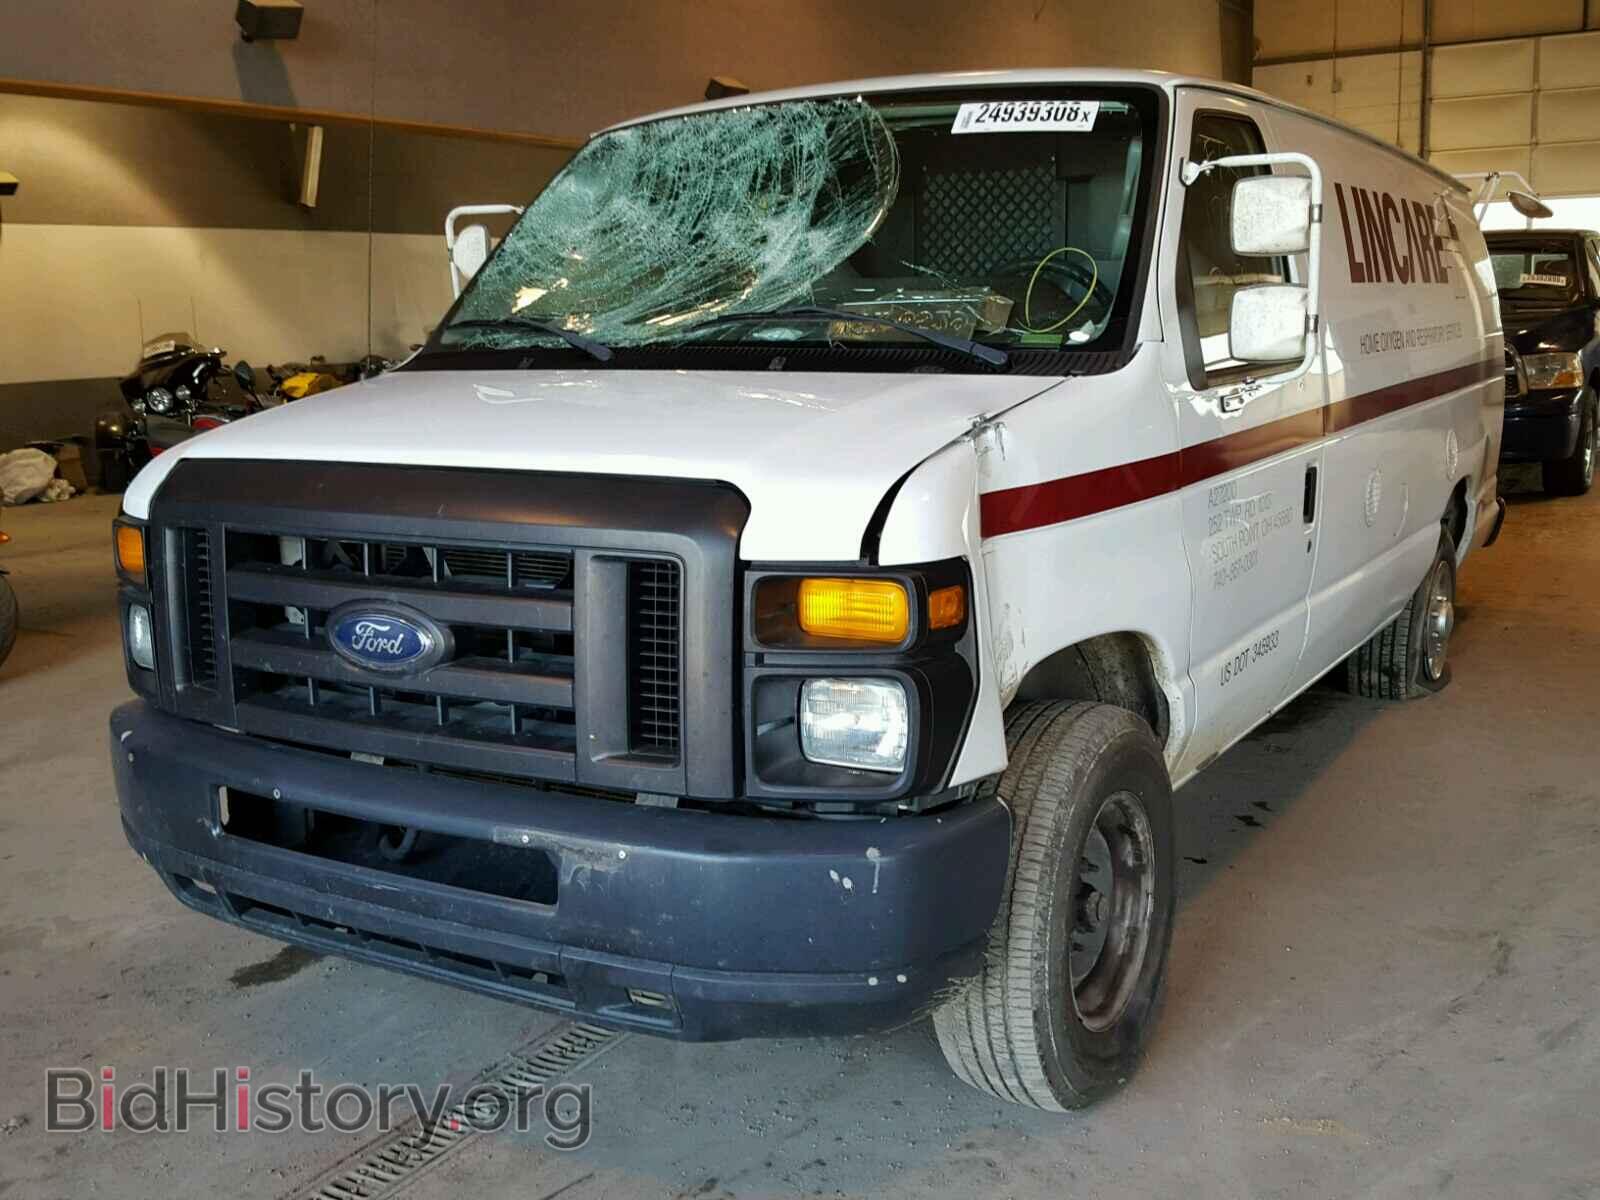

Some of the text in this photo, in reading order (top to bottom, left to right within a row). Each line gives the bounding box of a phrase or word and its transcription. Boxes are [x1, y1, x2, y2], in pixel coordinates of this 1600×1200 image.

[1334, 182, 1448, 284] LINCARE
[1360, 332, 1380, 354] HOME
[351, 621, 405, 655] Ford
[1218, 661, 1231, 687] US
[1233, 647, 1250, 677] DOT
